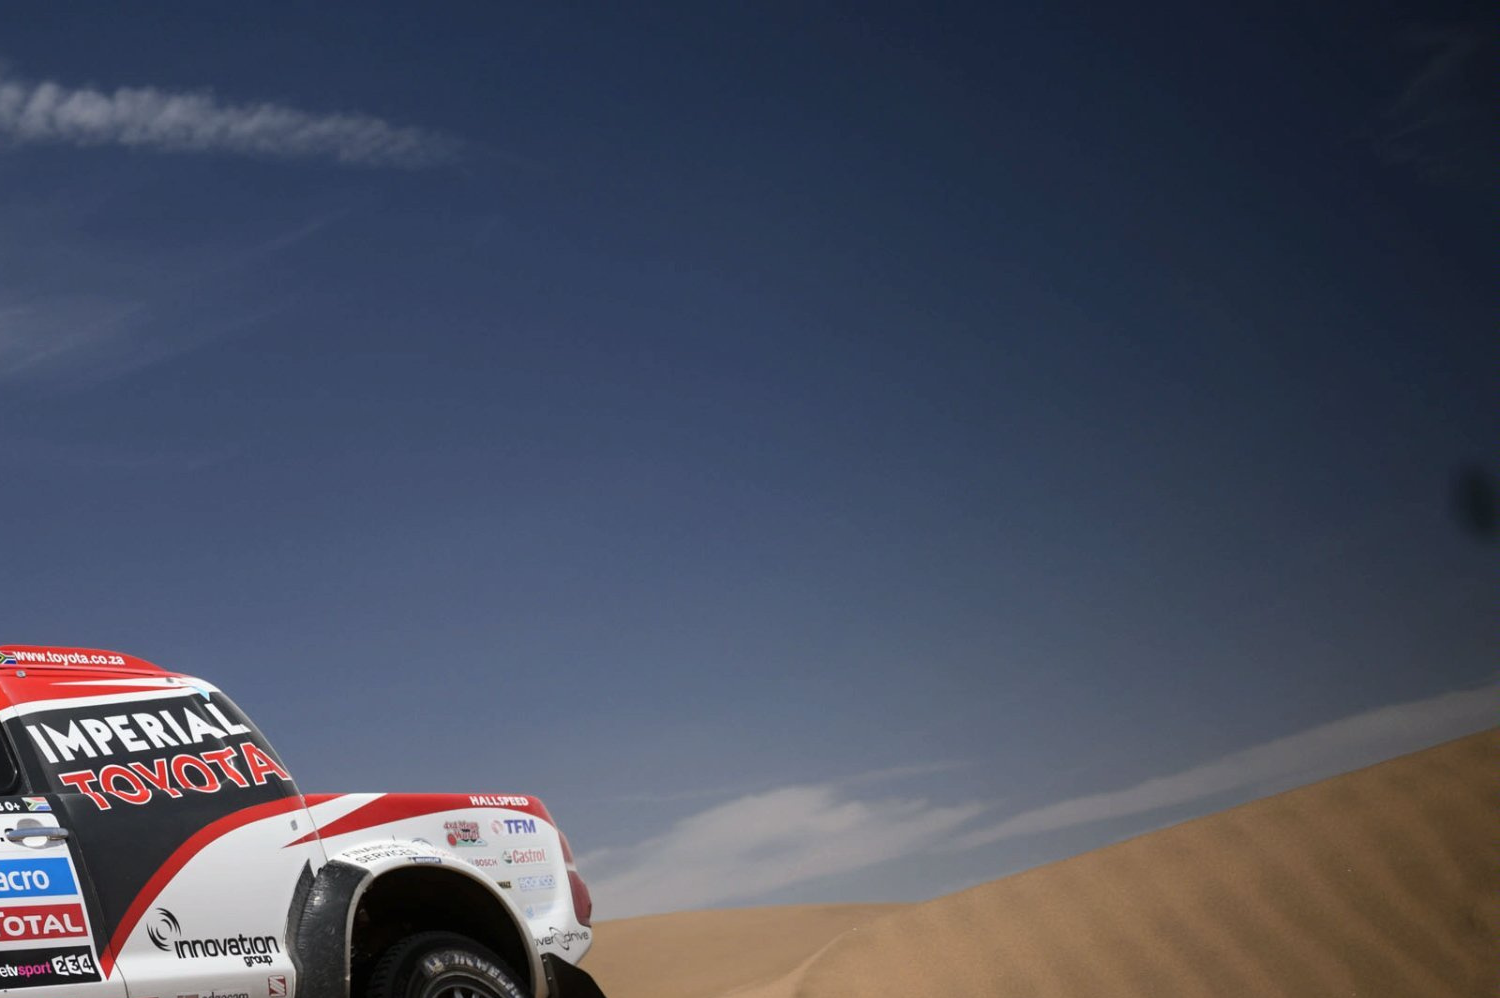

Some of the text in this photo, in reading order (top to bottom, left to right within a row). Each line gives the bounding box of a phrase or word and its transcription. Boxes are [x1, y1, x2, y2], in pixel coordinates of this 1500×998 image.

[14, 651, 125, 665] www.toyota.co.za
[26, 703, 251, 763] IMPERIAL
[59, 742, 292, 810] TOYOTA
[469, 796, 529, 806] HALLSPEED
[504, 819, 536, 834] TFM
[512, 848, 546, 864] Castrol
[174, 934, 281, 958] innovation
[244, 955, 273, 967] group
